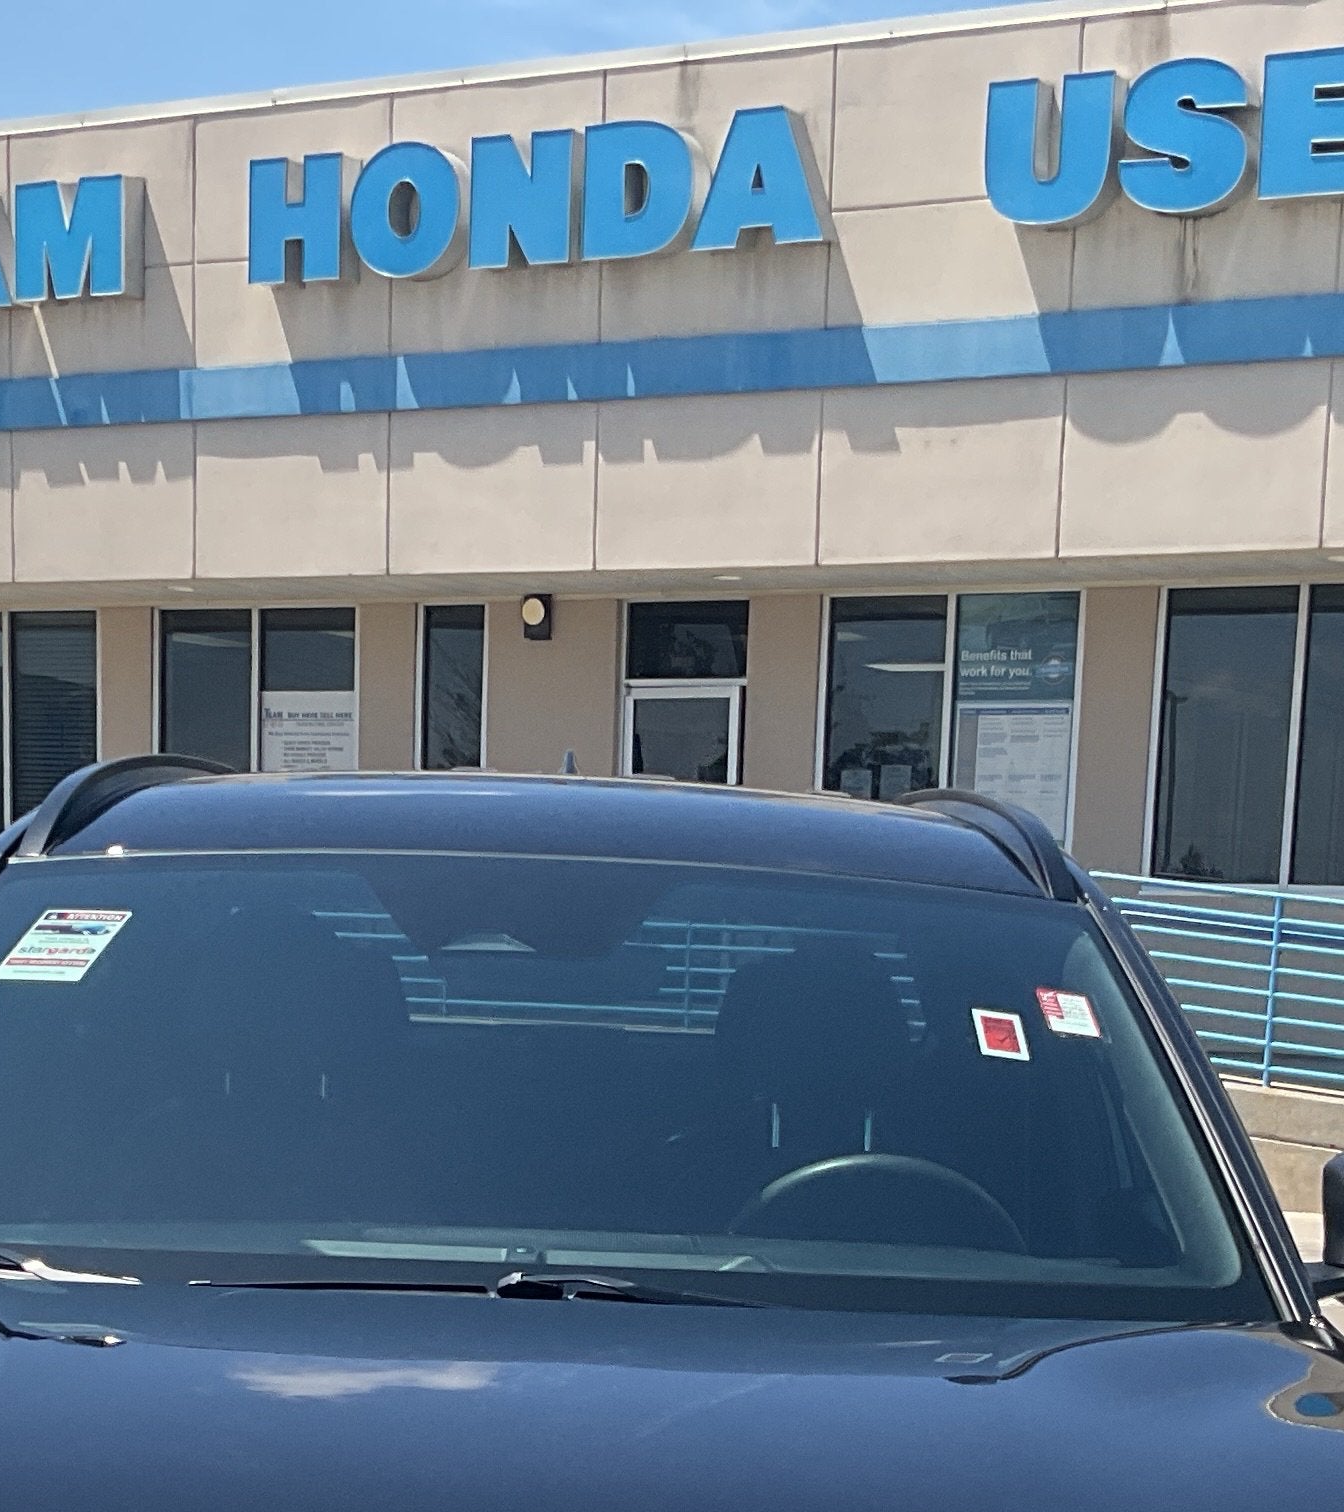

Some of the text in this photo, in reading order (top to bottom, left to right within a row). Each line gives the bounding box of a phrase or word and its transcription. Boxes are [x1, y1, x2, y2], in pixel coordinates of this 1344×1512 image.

[248, 104, 826, 283] HONDA
[961, 650, 1032, 661] Benefits that
[960, 665, 988, 677] work
[990, 665, 1006, 676] for
[1009, 667, 1033, 679] you.
[67, 912, 123, 921] ATTENTION
